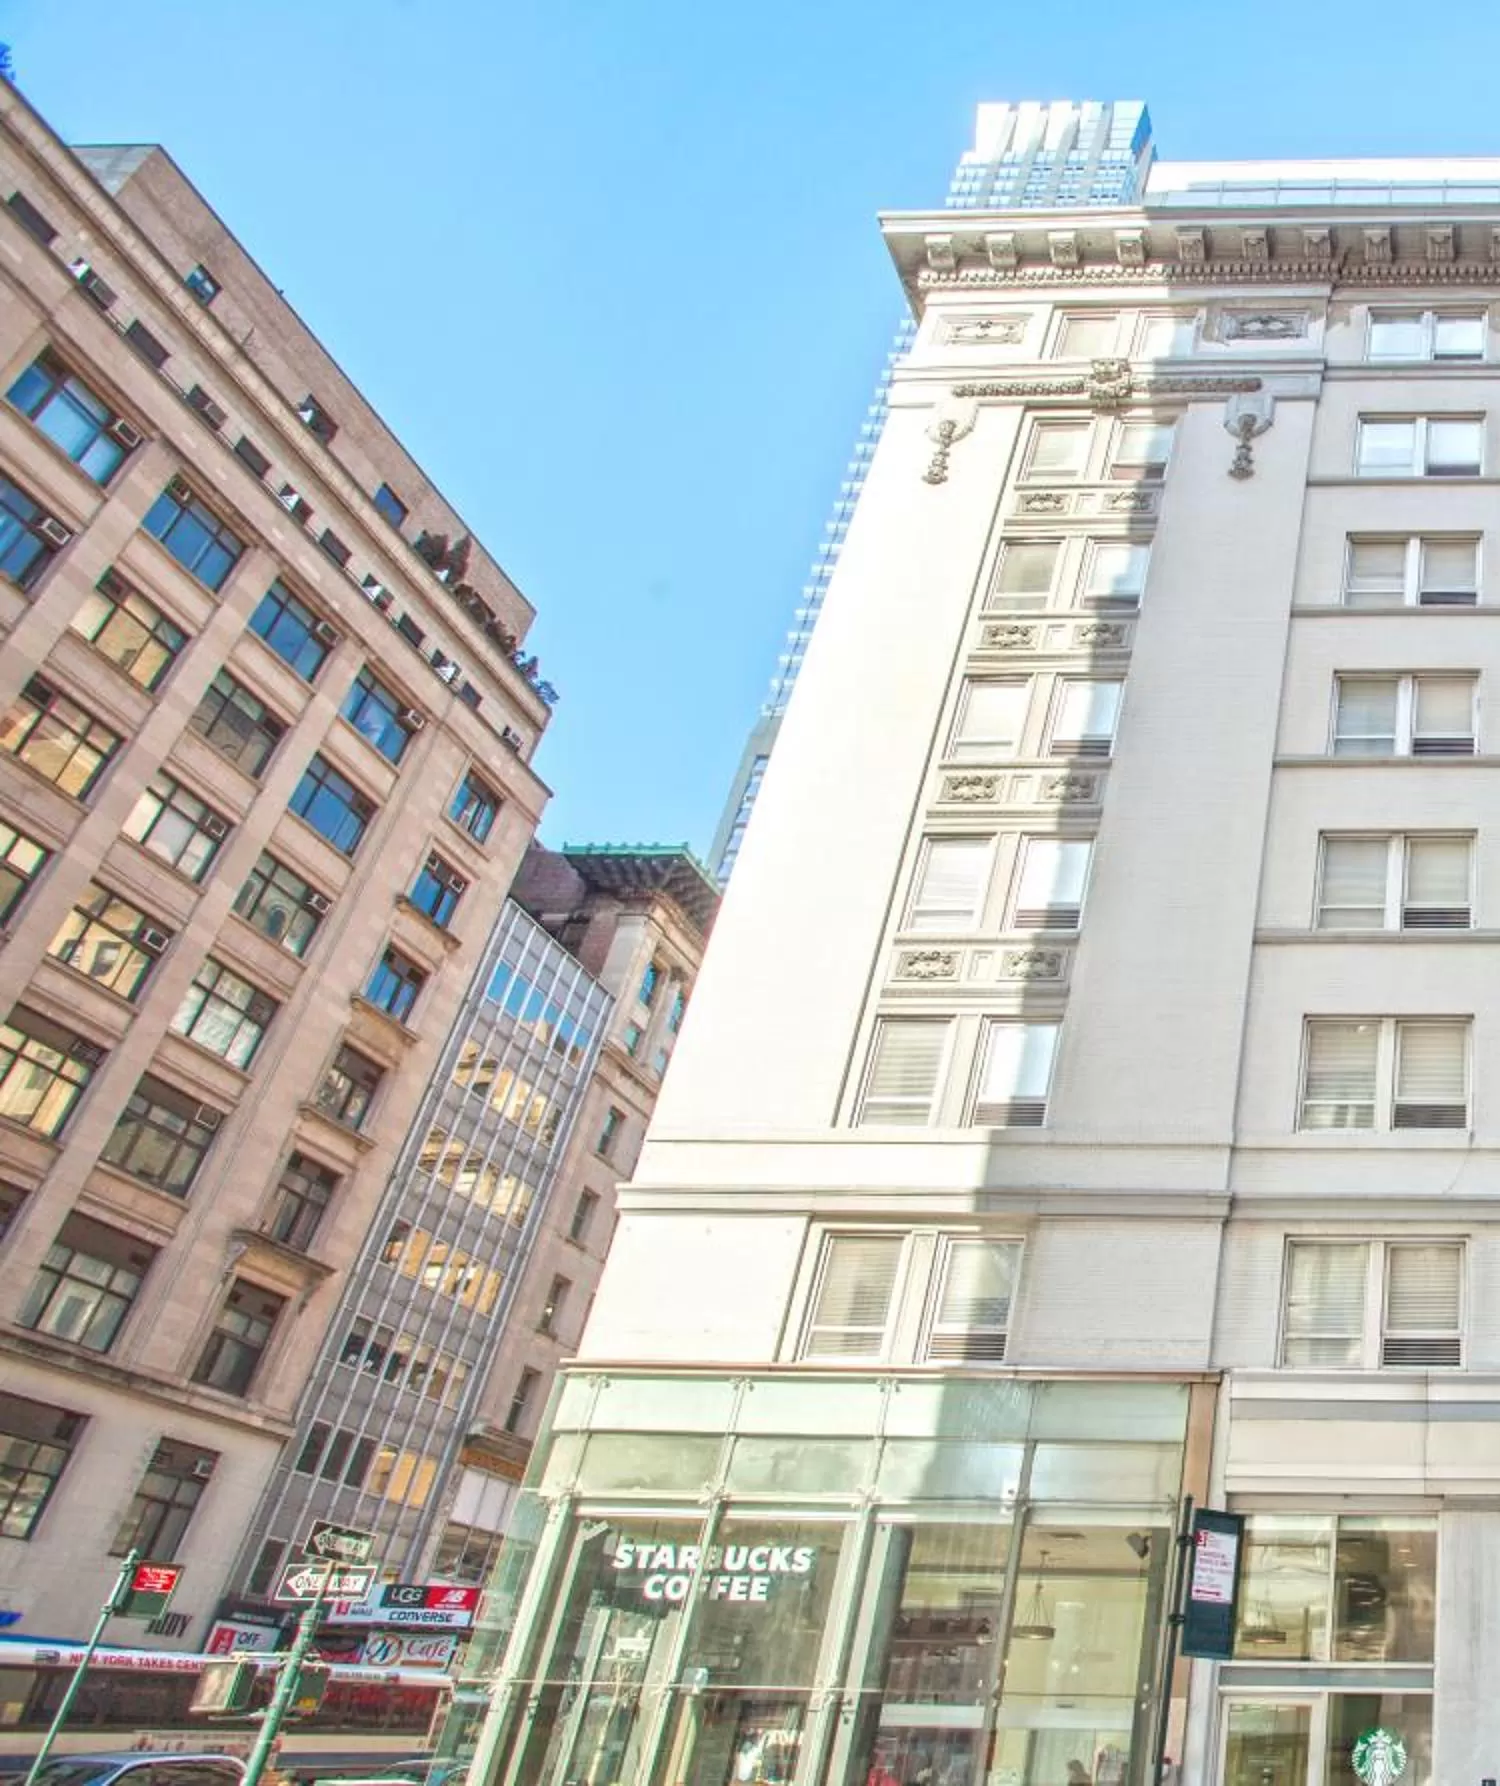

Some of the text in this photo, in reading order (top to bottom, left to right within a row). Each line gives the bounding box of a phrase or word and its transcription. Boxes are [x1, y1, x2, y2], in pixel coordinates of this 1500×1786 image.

[612, 1543, 815, 1572] STARBUCKS
[295, 1575, 361, 1591] ONE WAY
[391, 1587, 423, 1603] UGG
[388, 1610, 455, 1623] CONVERSE
[102, 1654, 135, 1668] YORK
[138, 1656, 173, 1669] TAKES
